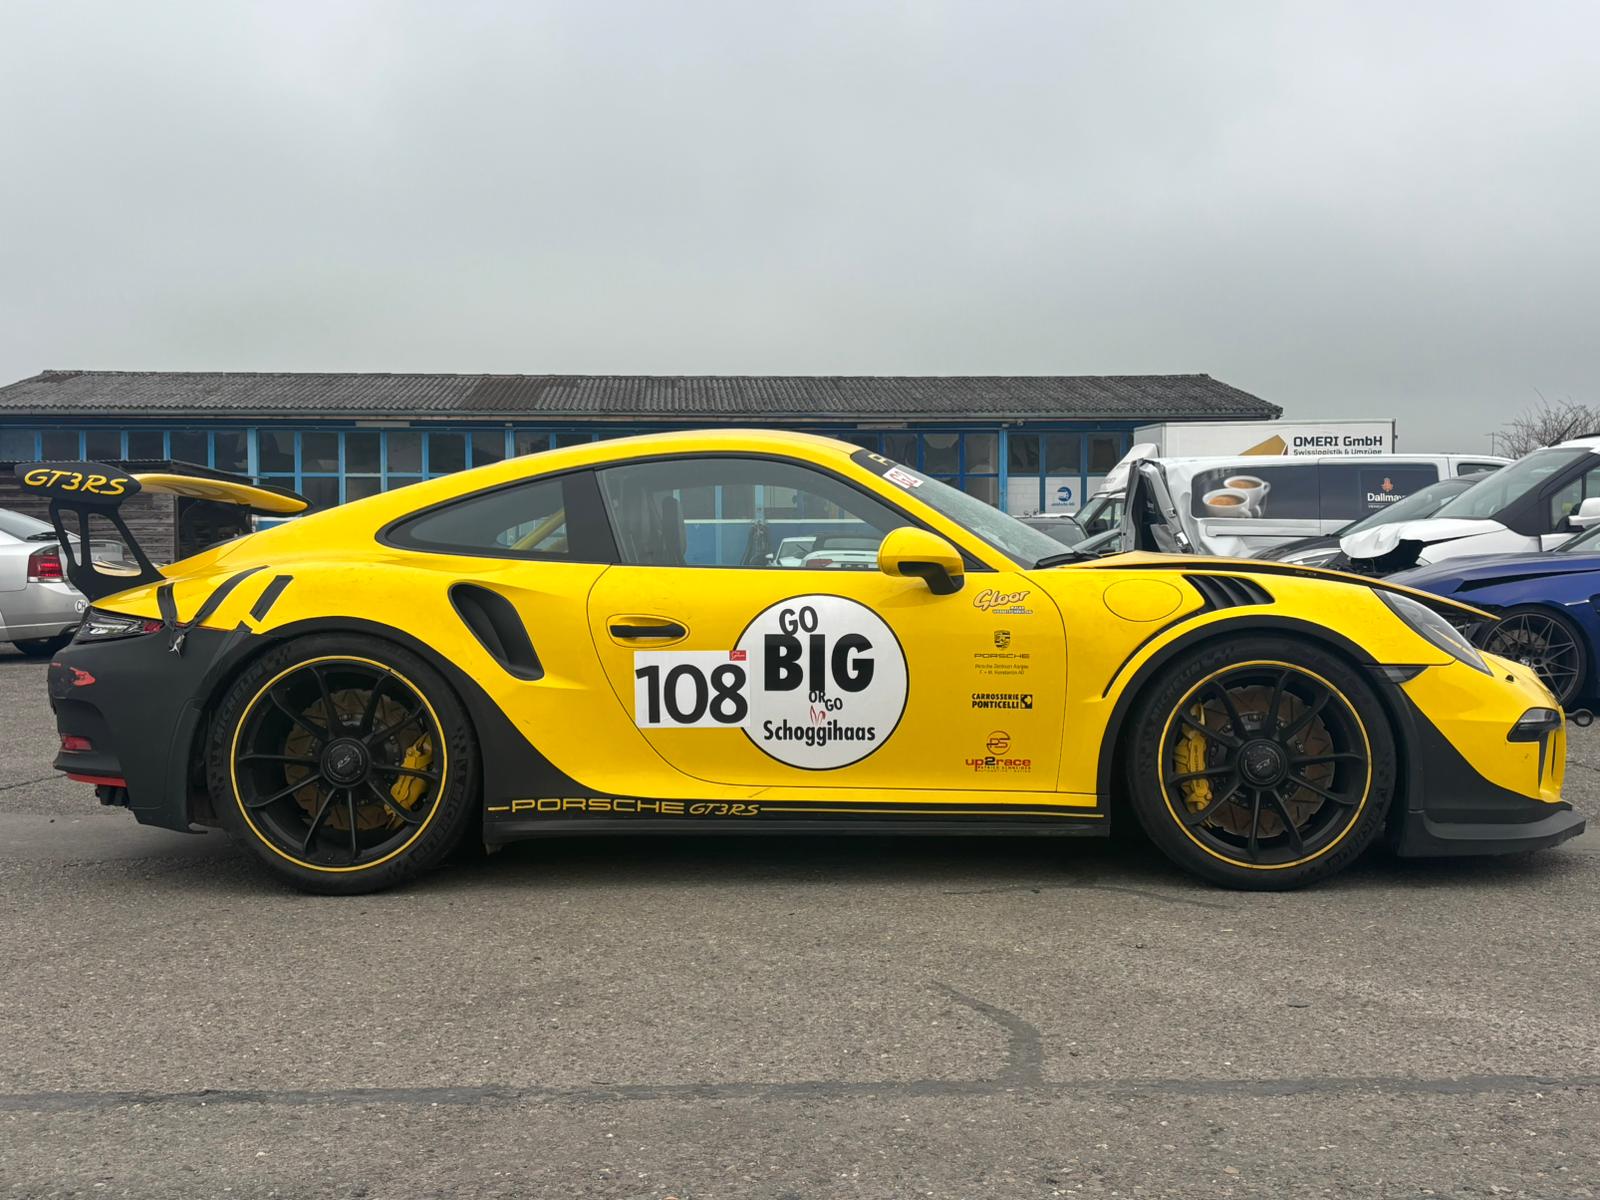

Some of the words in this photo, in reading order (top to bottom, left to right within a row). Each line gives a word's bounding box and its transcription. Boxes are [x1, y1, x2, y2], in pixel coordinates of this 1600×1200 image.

[1293, 436, 1339, 447] OMERI
[1343, 436, 1383, 447] GmbH
[24, 469, 128, 495] GT3RS
[973, 589, 1030, 611] Gloor
[779, 606, 819, 635] GO
[764, 633, 875, 693] BIG
[635, 664, 748, 724] 108
[809, 690, 825, 703] OR
[825, 697, 843, 712] GO
[972, 701, 1019, 709] PONTICELLI
[763, 719, 876, 746] Schoggihaas
[965, 757, 1031, 772] up2race
[512, 798, 685, 814] PORSCHE
[689, 803, 759, 816] GT3RS
